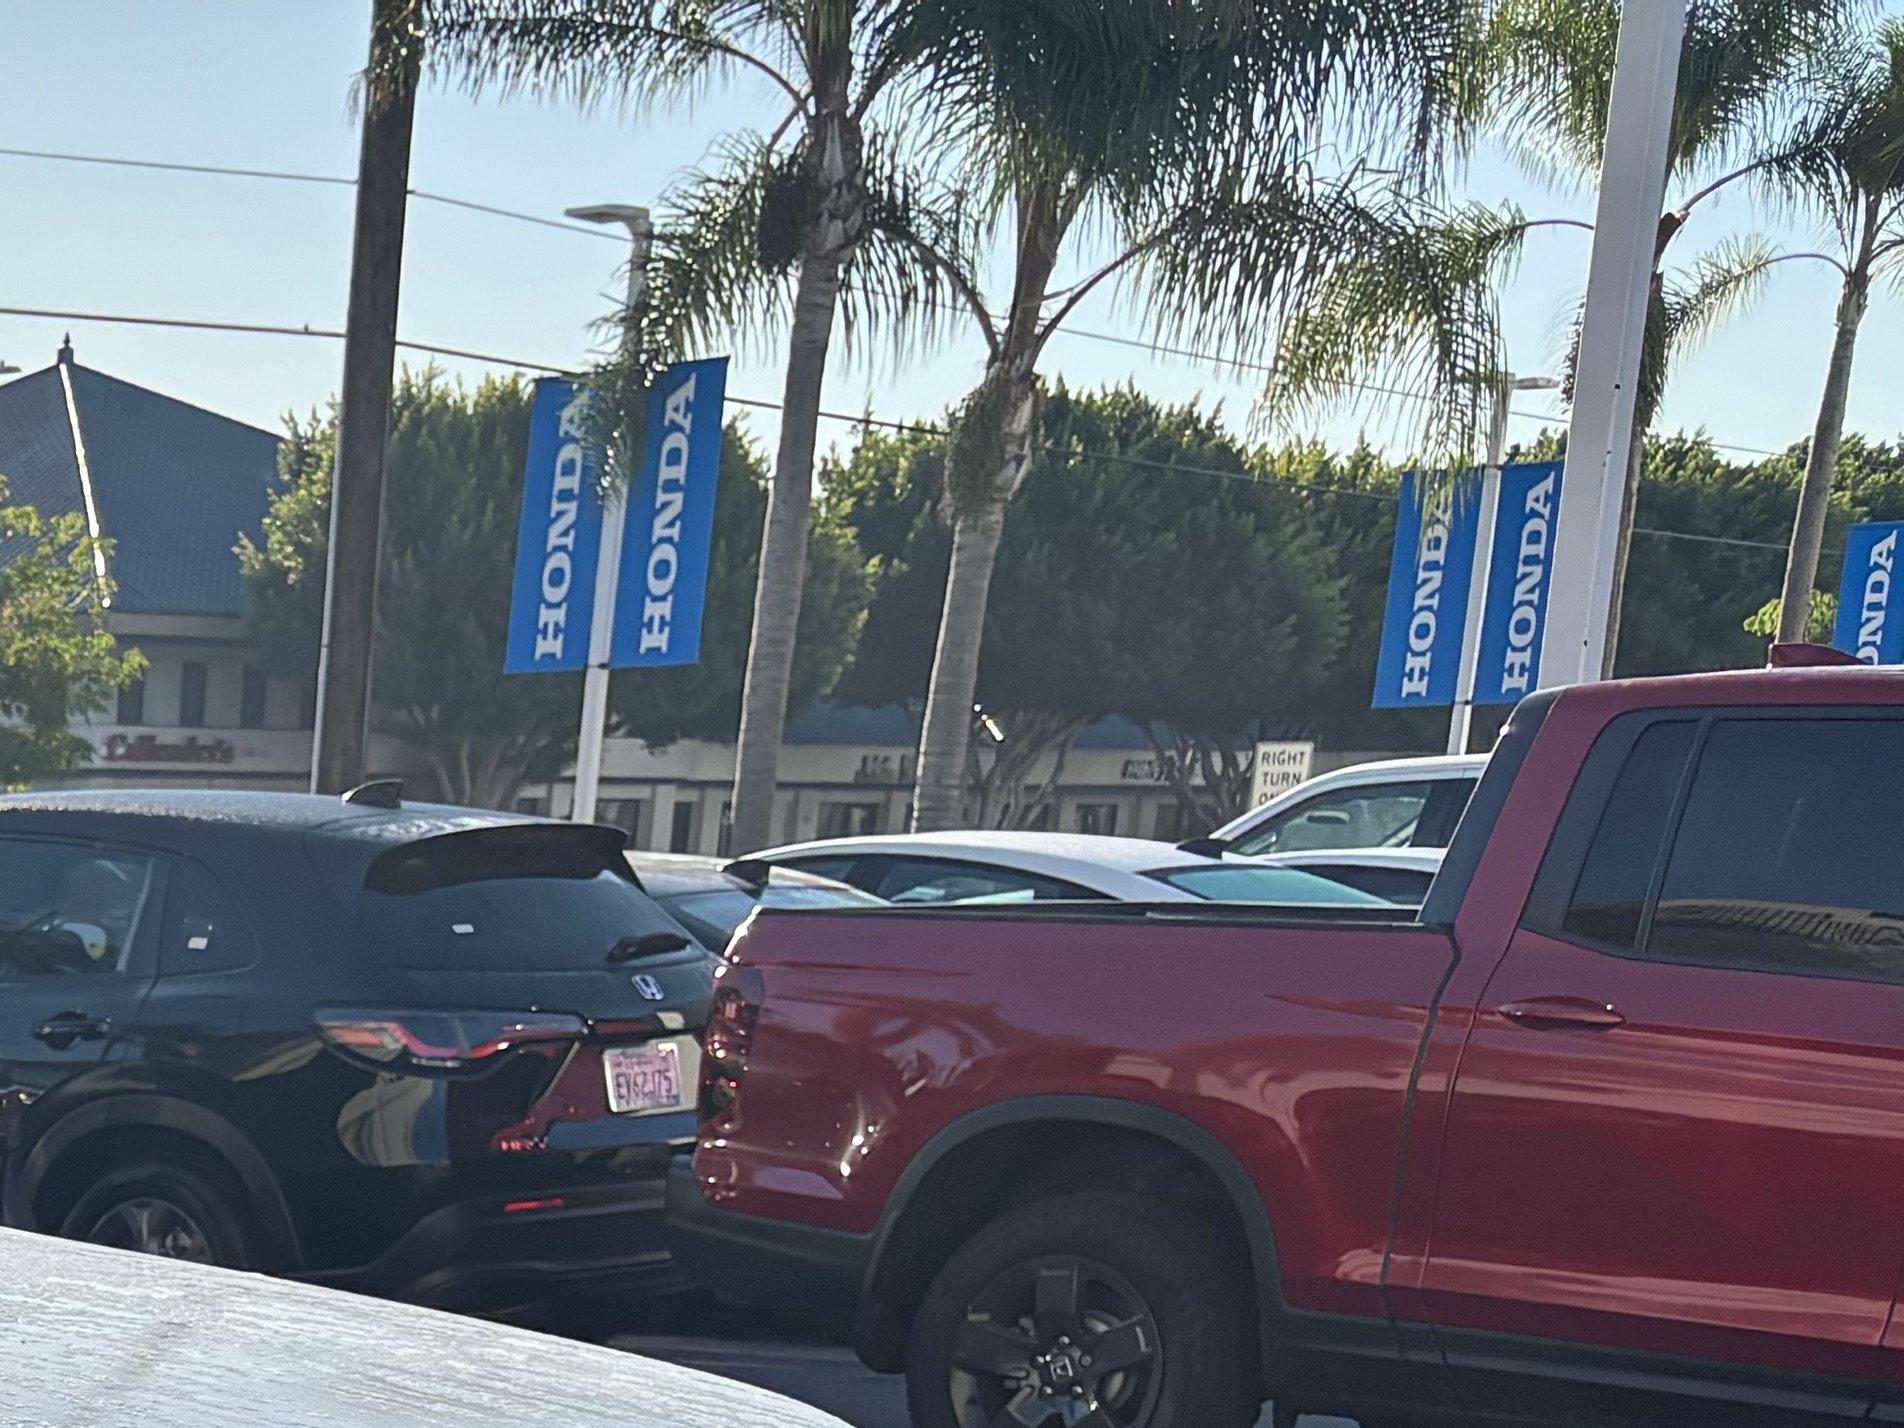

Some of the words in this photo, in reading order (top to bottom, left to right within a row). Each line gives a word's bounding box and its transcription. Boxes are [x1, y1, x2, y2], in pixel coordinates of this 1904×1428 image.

[534, 387, 590, 661] HONDA
[639, 372, 696, 655] HONDA
[1502, 470, 1555, 694] HONDA
[1262, 749, 1305, 766] RIGHT
[1263, 771, 1301, 787] TURN
